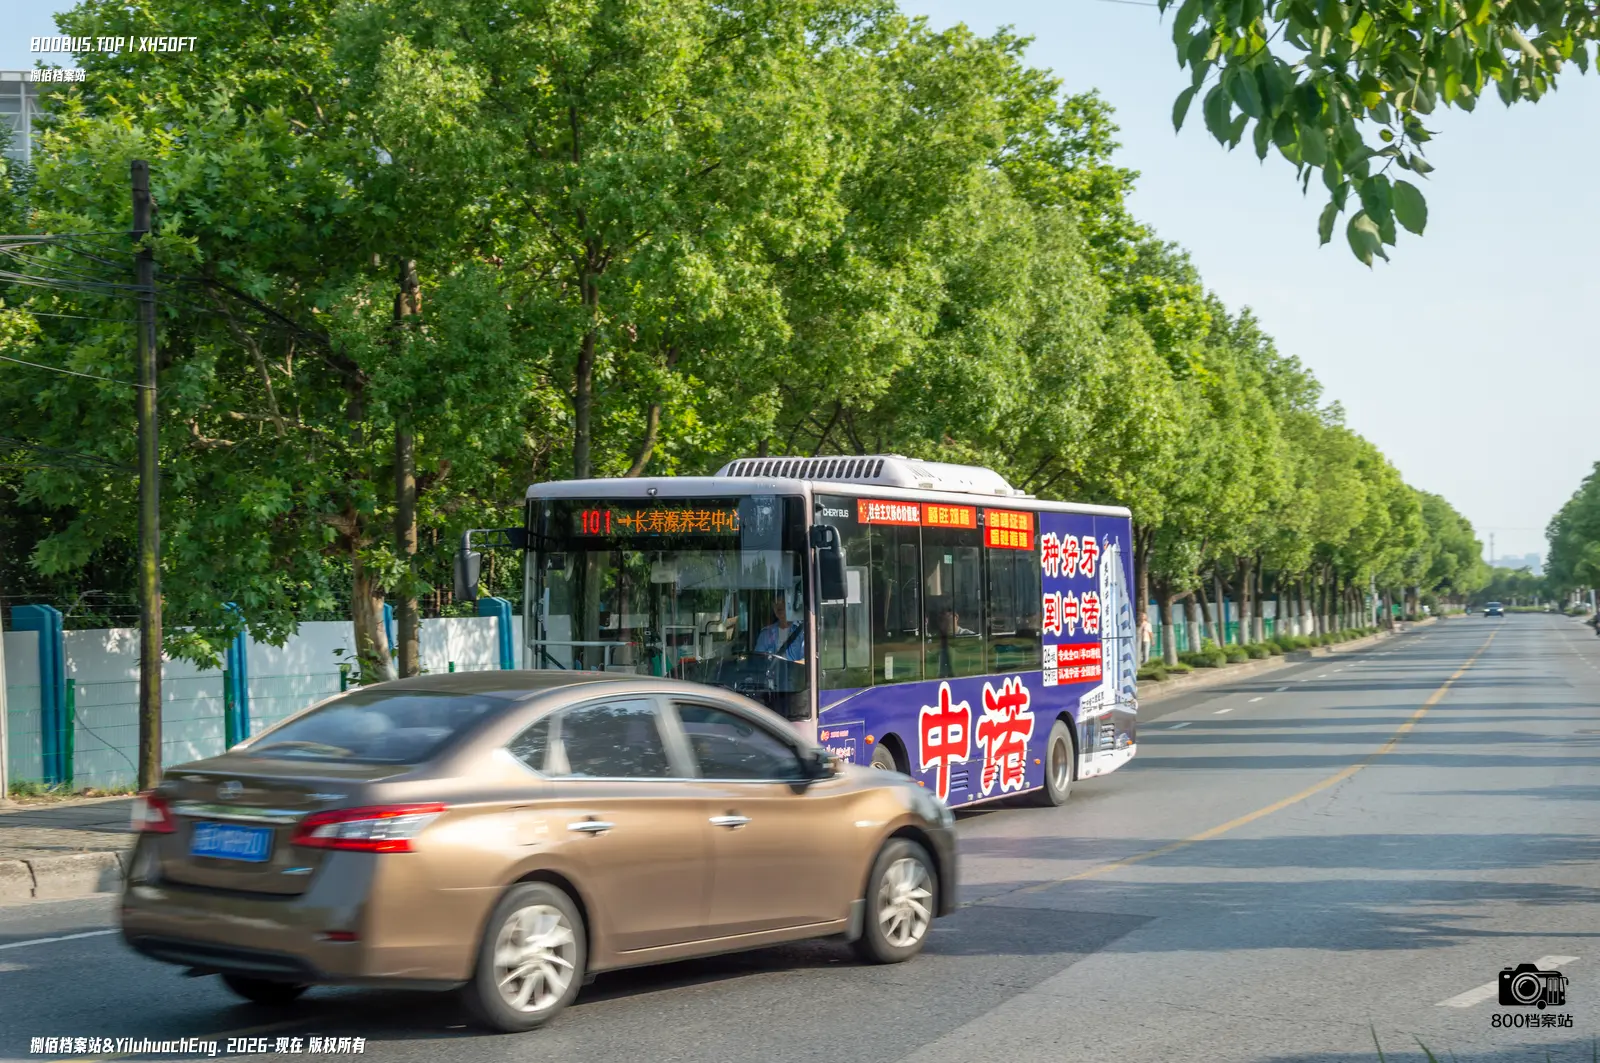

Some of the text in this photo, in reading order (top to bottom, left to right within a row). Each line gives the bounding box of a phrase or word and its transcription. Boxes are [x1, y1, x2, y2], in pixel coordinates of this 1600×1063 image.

[581, 510, 612, 534] 101
[634, 509, 740, 533] 长寿源养老中心
[823, 508, 849, 517] CHERY BUS
[1041, 532, 1100, 578] 种好牙
[1043, 590, 1101, 636] 到中诺
[919, 676, 1035, 803] 中诺
